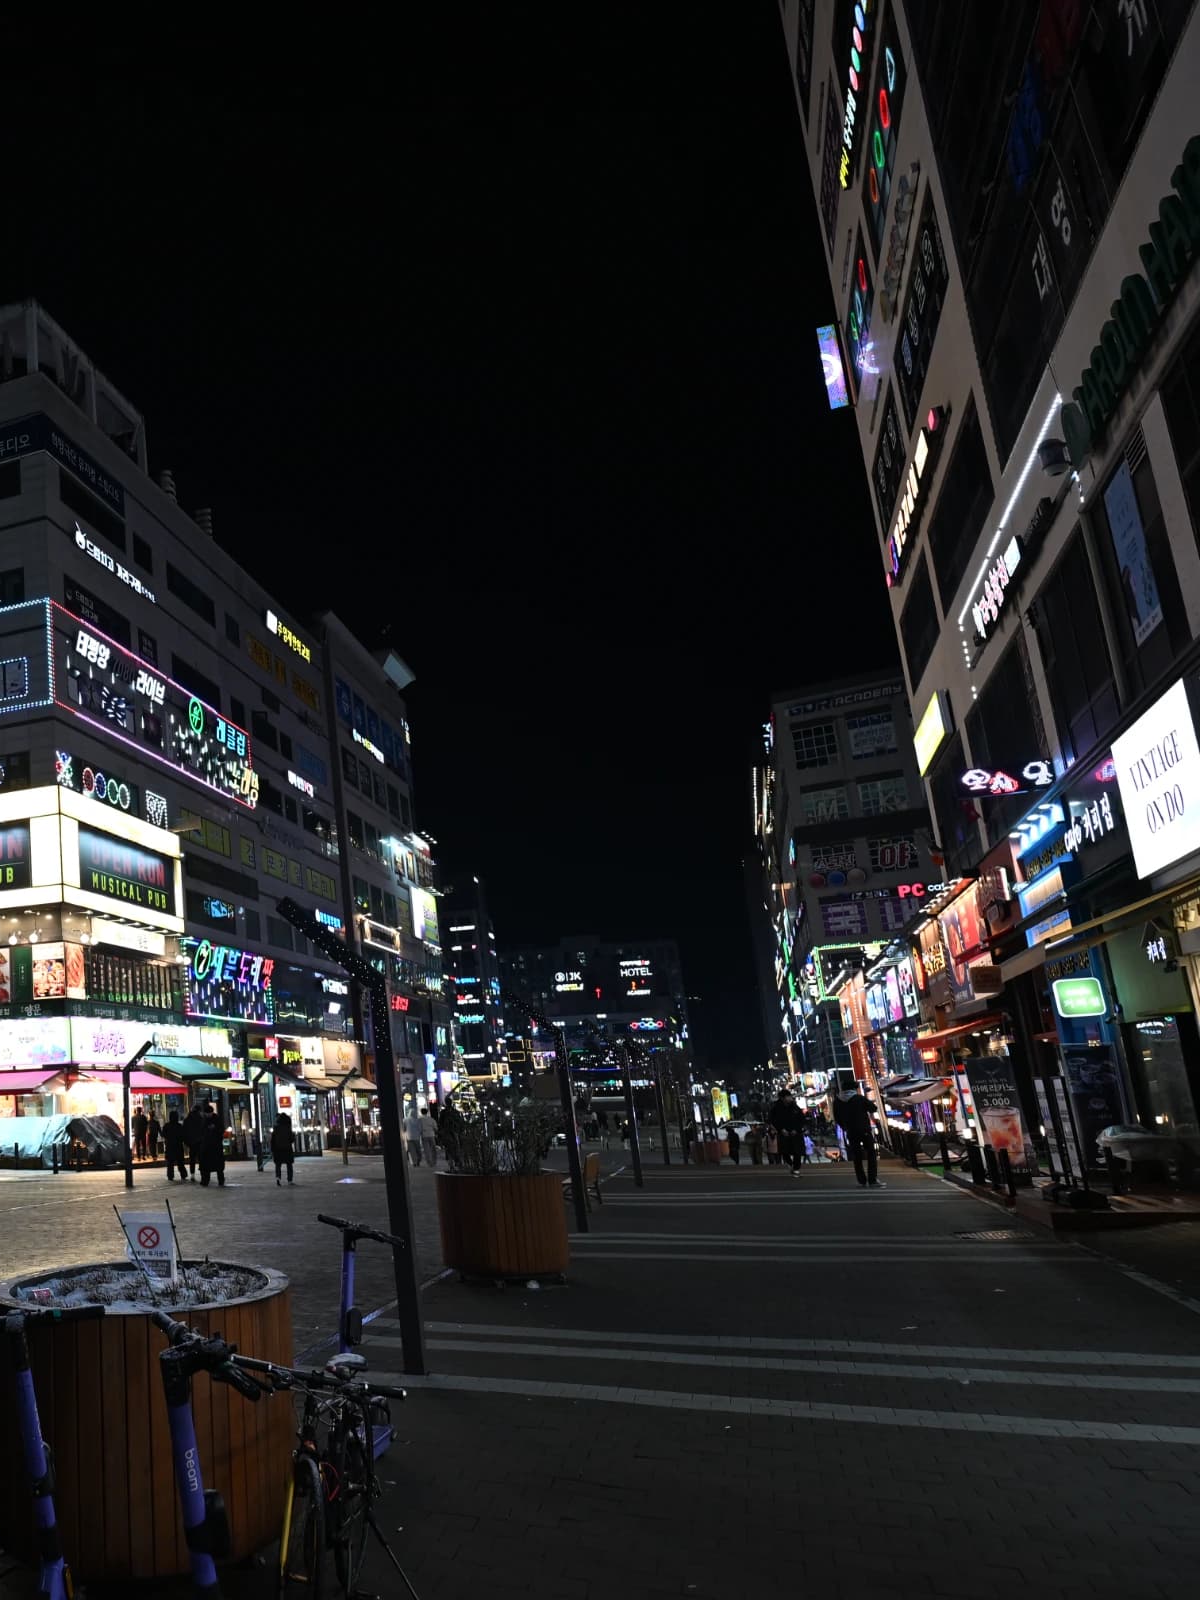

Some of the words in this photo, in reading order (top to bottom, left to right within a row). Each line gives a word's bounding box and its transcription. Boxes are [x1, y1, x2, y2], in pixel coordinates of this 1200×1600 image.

[76, 630, 110, 670] 태평양
[136, 669, 166, 705] 라이브
[1129, 728, 1184, 793] VINTAGE
[1083, 791, 1114, 843] 커피집
[90, 841, 132, 876] OPEN
[137, 857, 165, 887] RUN
[92, 872, 142, 903] MUSICAL
[148, 891, 167, 910] PUB
[897, 882, 926, 899] PC
[620, 968, 652, 978] HOTEL
[972, 1083, 1016, 1093] 아메리카노
[184, 1447, 199, 1493] beam
